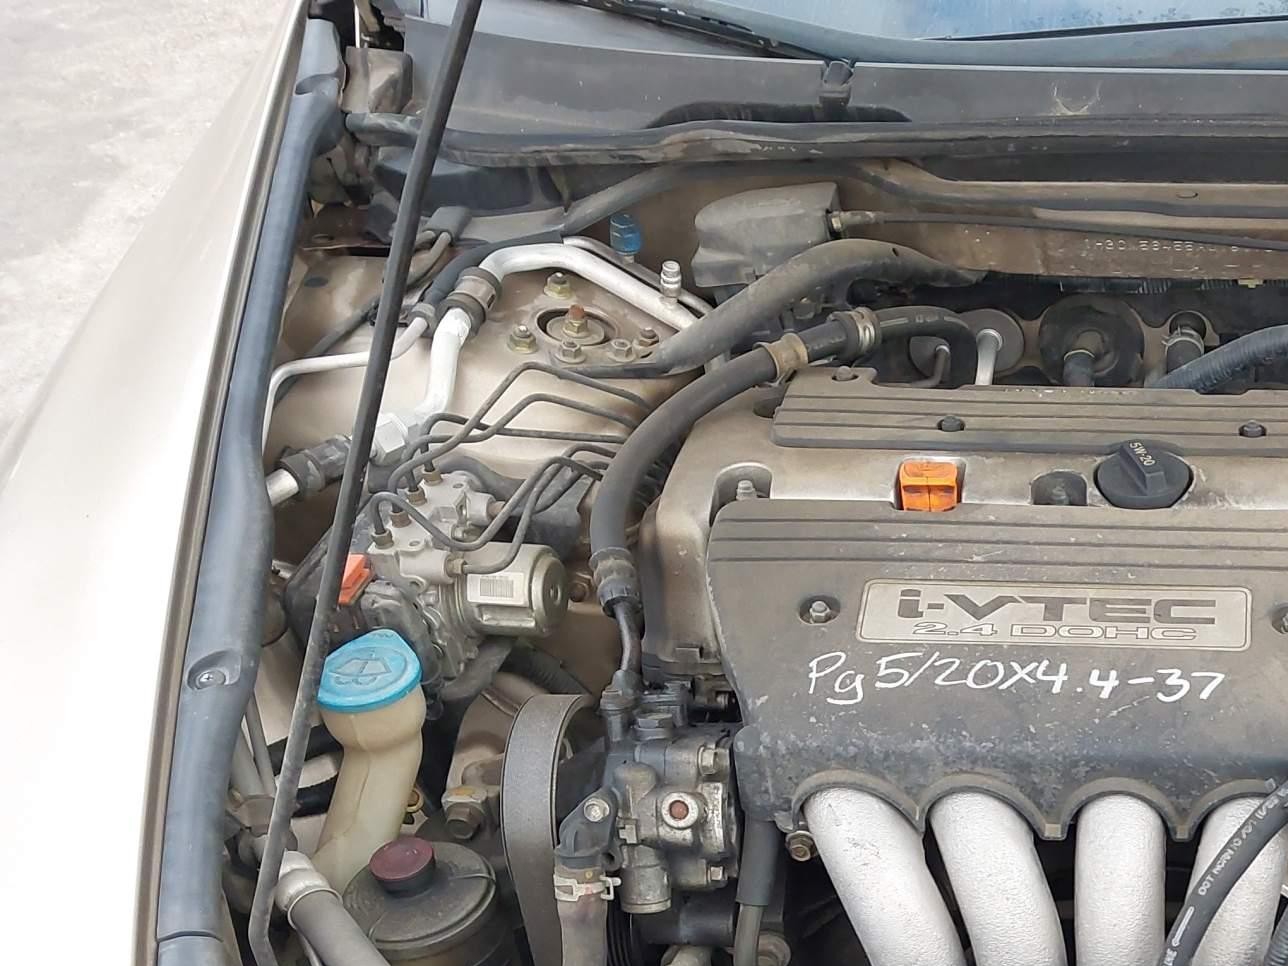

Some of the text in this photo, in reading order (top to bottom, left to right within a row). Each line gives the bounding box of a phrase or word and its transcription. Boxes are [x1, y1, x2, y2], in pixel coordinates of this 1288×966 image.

[897, 588, 1216, 625] i-VTEC
[912, 622, 1197, 641] 2.4 DOHC
